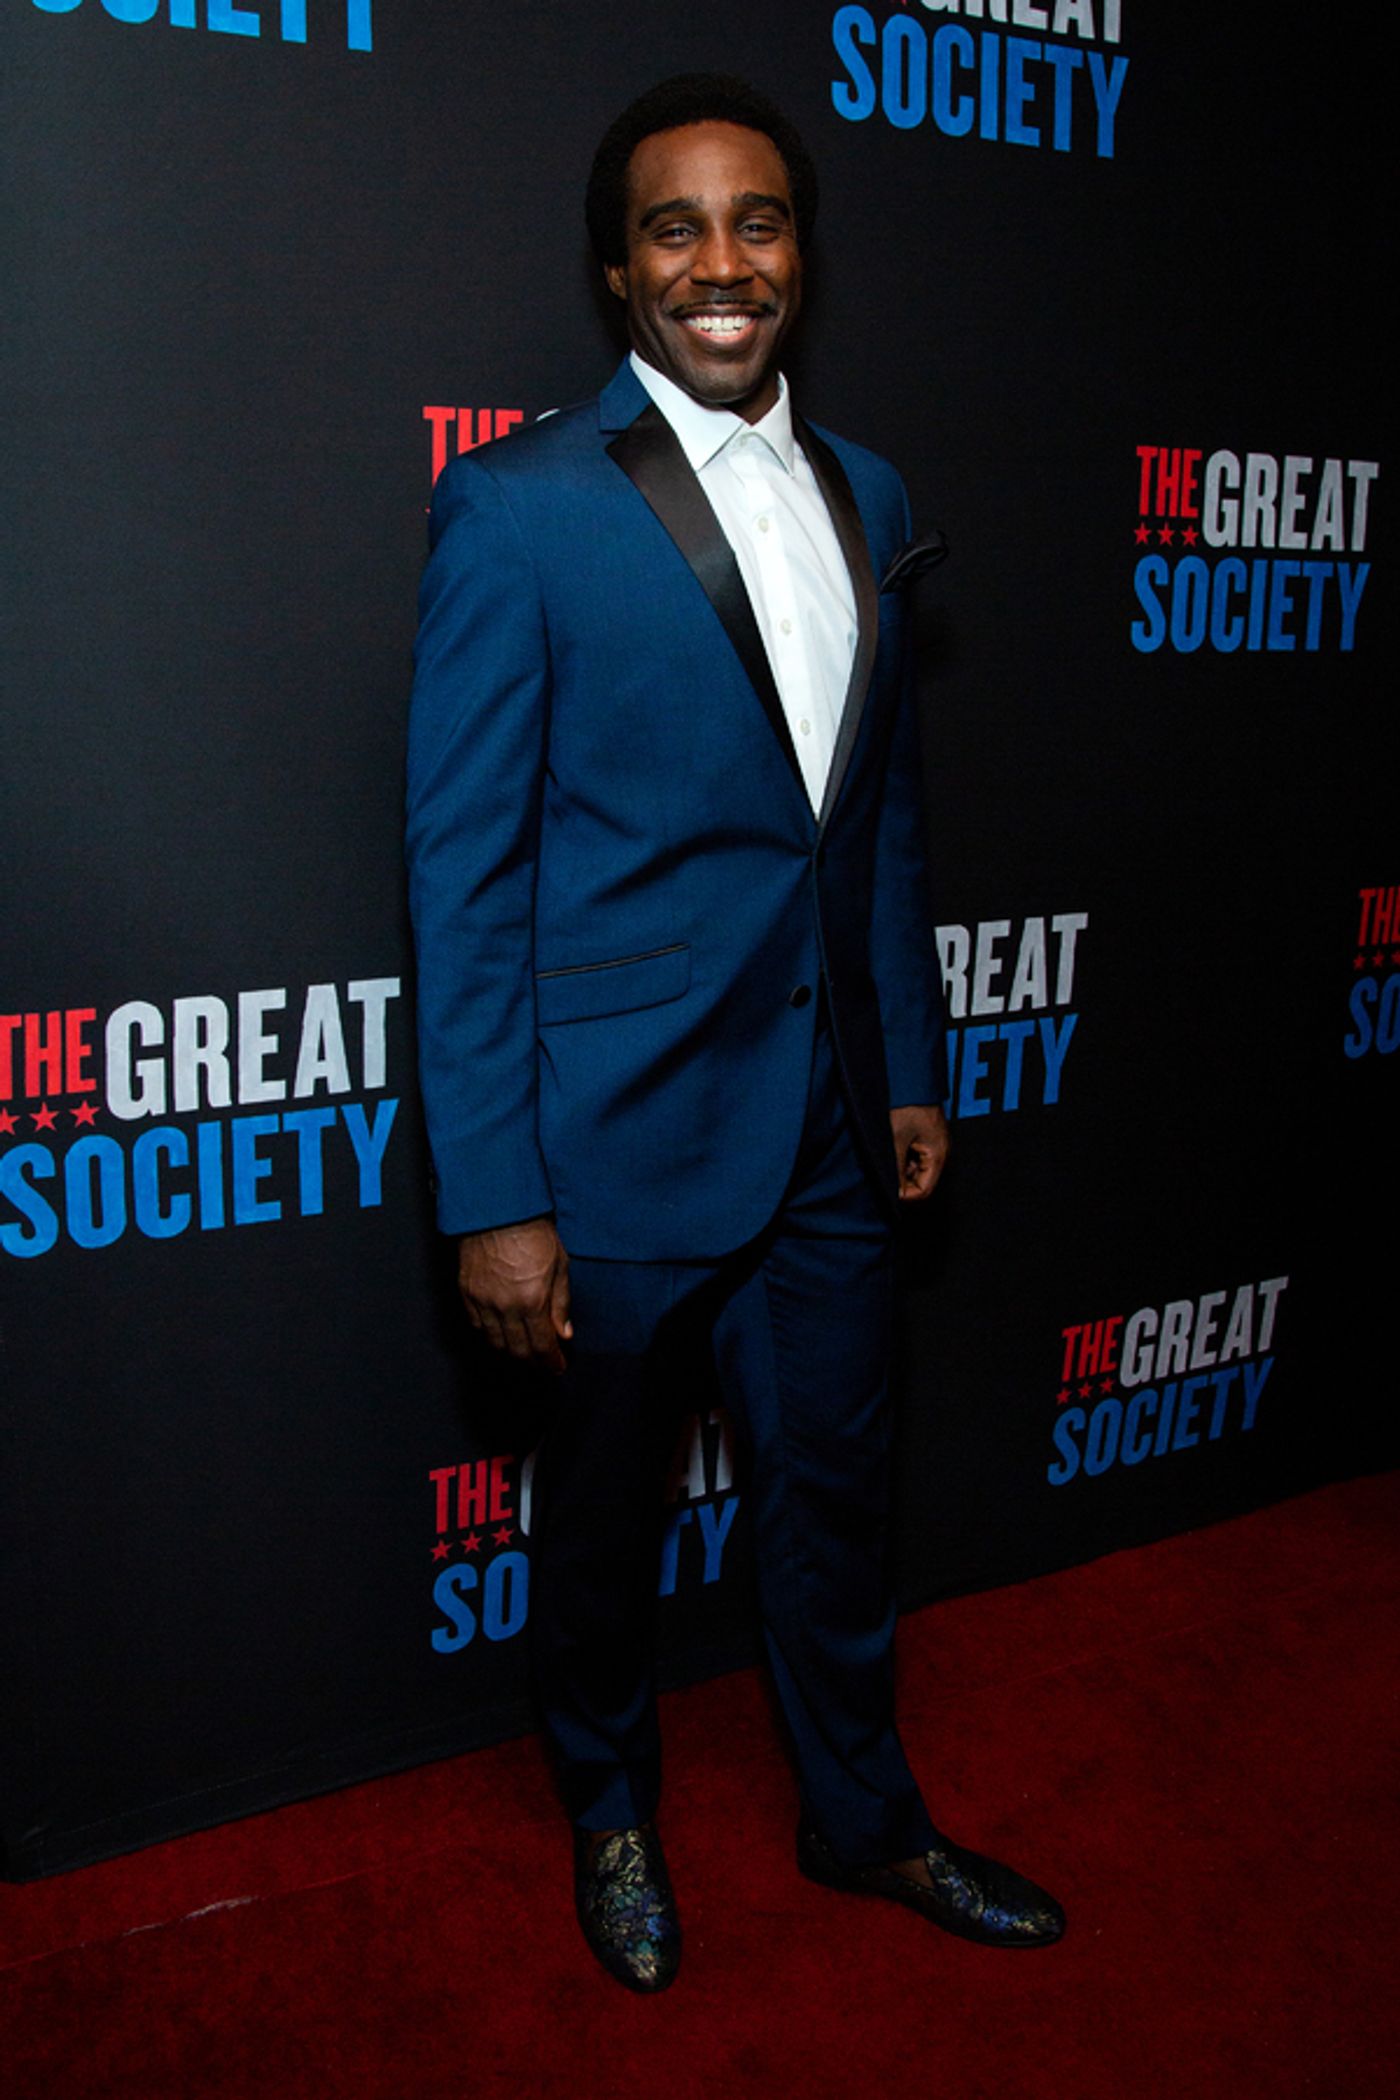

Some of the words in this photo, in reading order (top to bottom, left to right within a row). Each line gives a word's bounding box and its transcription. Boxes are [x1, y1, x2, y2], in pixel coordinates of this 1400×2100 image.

[831, 4, 1131, 160] SOCIETY
[1136, 445, 1202, 518] THE
[1203, 448, 1381, 553] GREAT
[1129, 552, 1372, 654] SOCIETY
[934, 912, 1089, 1019] REAT
[0, 1008, 97, 1100] THE
[105, 977, 400, 1121] GREAT
[944, 1013, 1080, 1121] IETY
[0, 1097, 399, 1259] SOCIETY
[1061, 1314, 1125, 1383] THE
[1119, 1274, 1291, 1388] GREAT
[1046, 1355, 1278, 1487] SOCIETY
[429, 1454, 516, 1535] THE
